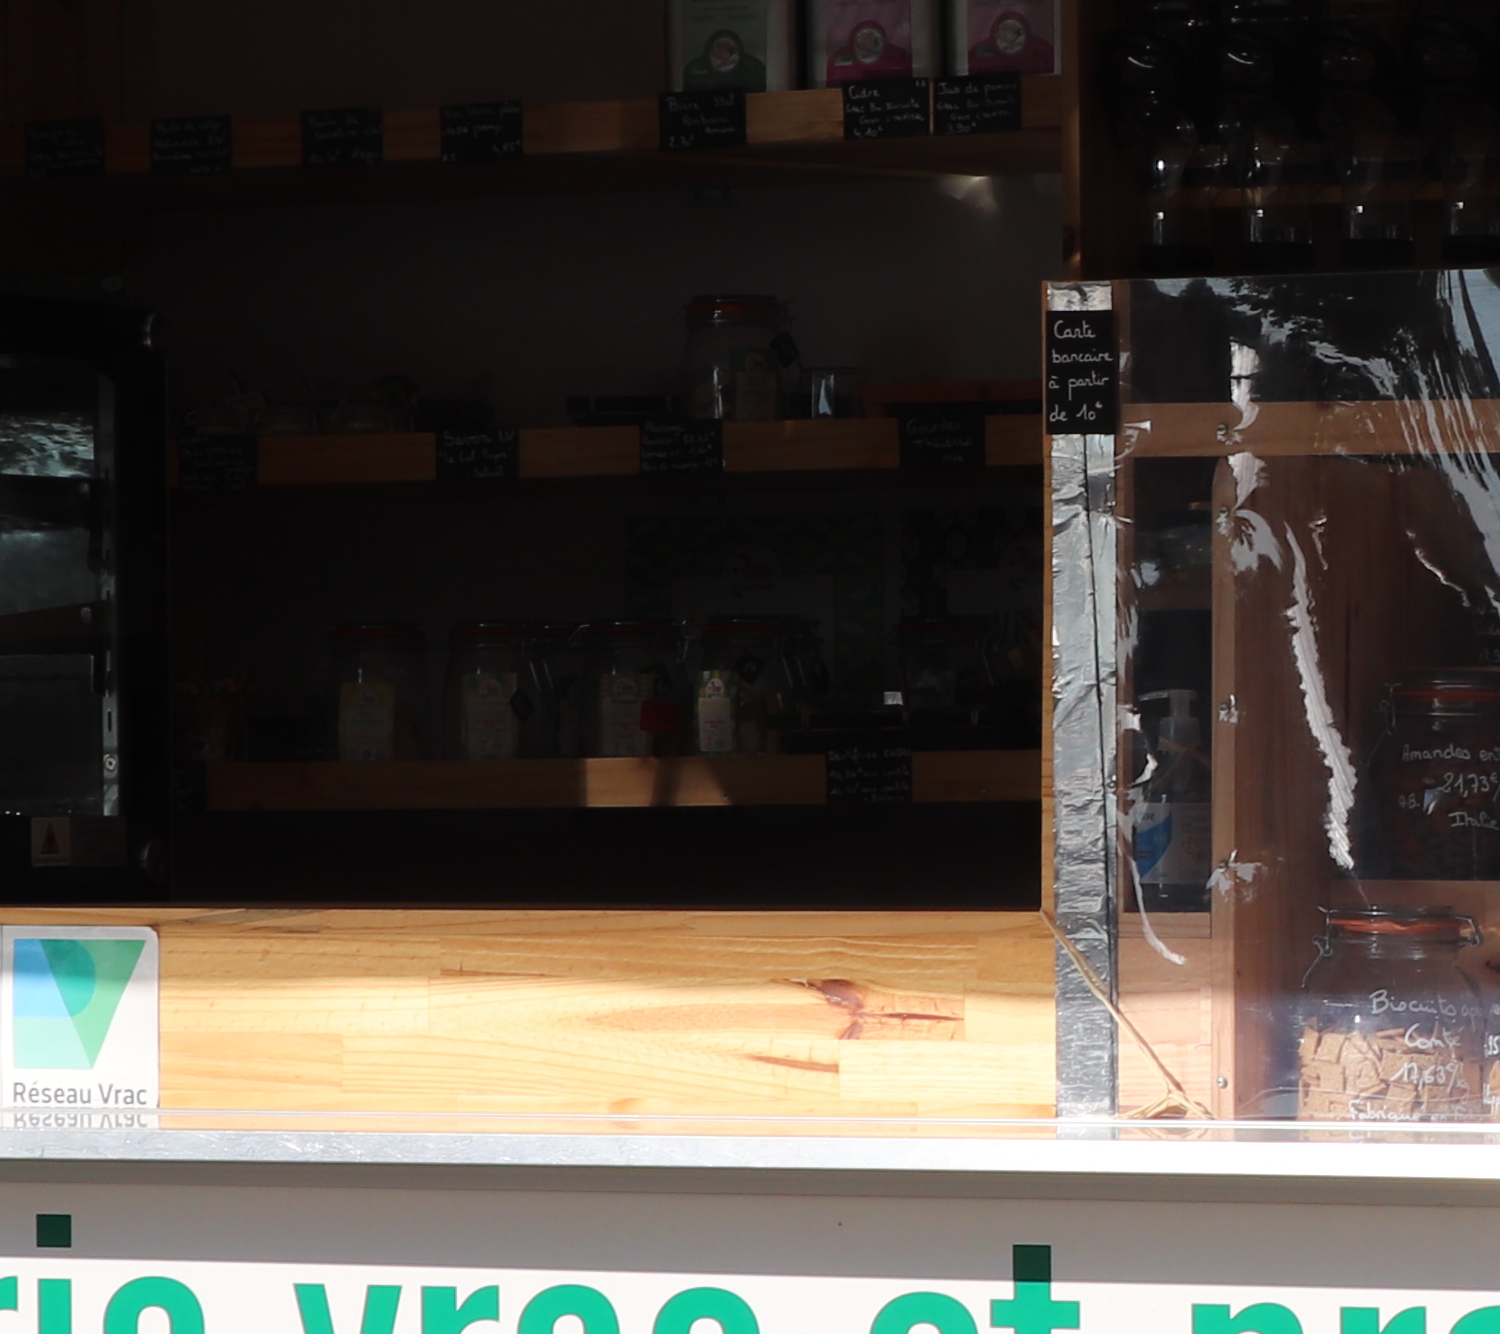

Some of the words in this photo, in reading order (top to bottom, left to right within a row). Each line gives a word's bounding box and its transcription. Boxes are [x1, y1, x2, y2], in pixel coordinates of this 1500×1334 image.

[1053, 319, 1096, 339] Carte
[1052, 348, 1113, 364] bancaire
[1048, 375, 1060, 390] à
[1067, 370, 1110, 402] partir
[1049, 403, 1068, 422] de
[12, 1080, 92, 1105] Réseau
[97, 1083, 148, 1106] Vrac
